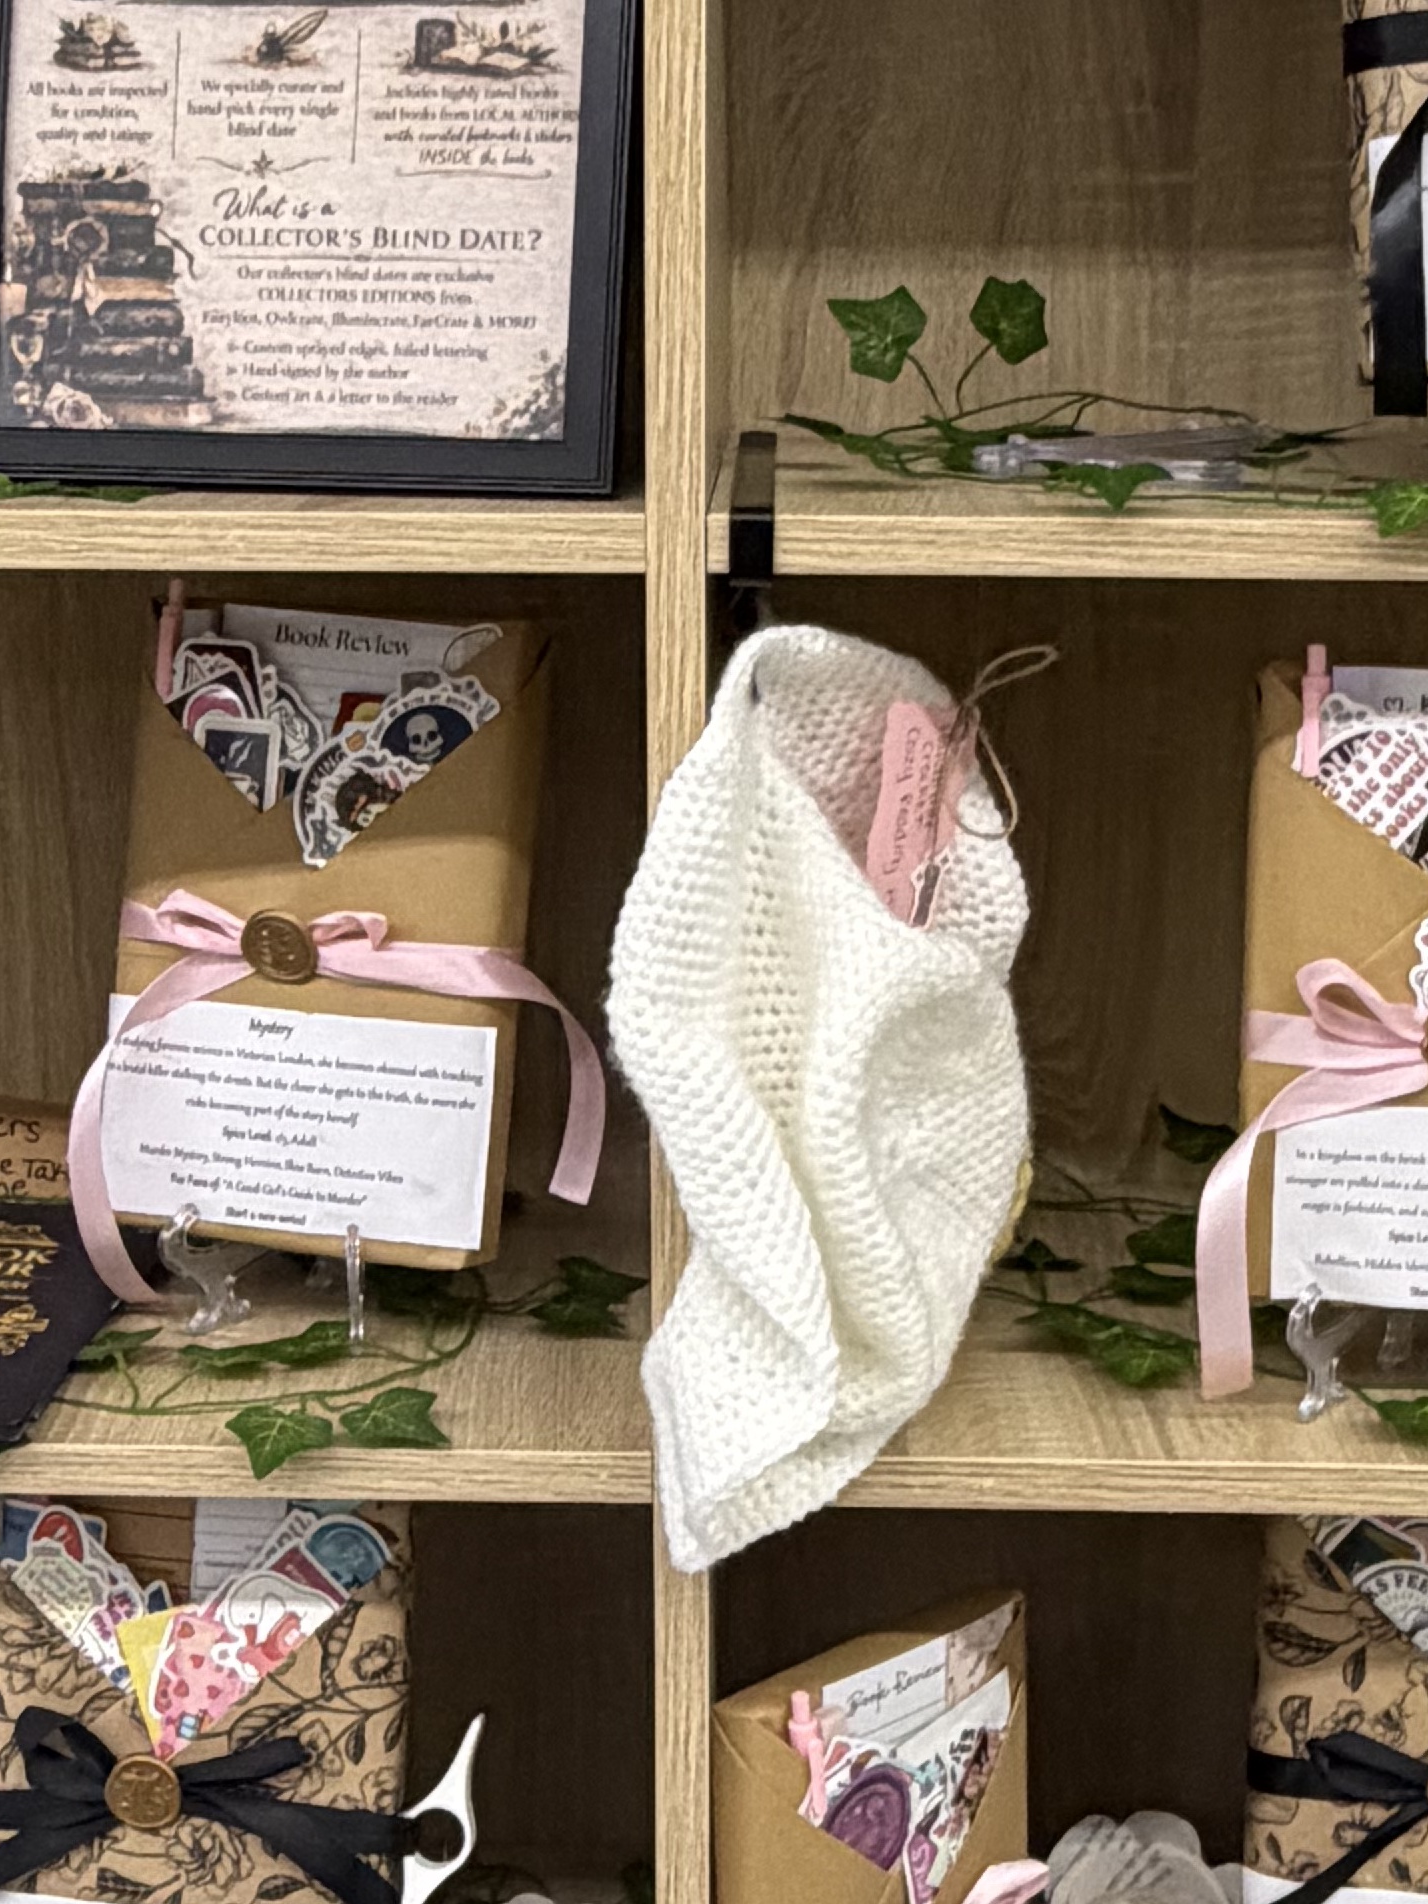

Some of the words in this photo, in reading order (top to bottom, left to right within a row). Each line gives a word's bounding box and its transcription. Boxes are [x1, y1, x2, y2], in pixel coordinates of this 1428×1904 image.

[214, 186, 286, 221] What
[293, 195, 315, 218] is
[320, 201, 337, 217] a
[199, 225, 362, 249] COLLECTOR'S
[373, 228, 450, 250] BLIND
[459, 229, 542, 251] DATE?
[1385, 793, 1427, 838] ooks
[22, 1157, 70, 1180] Tak
